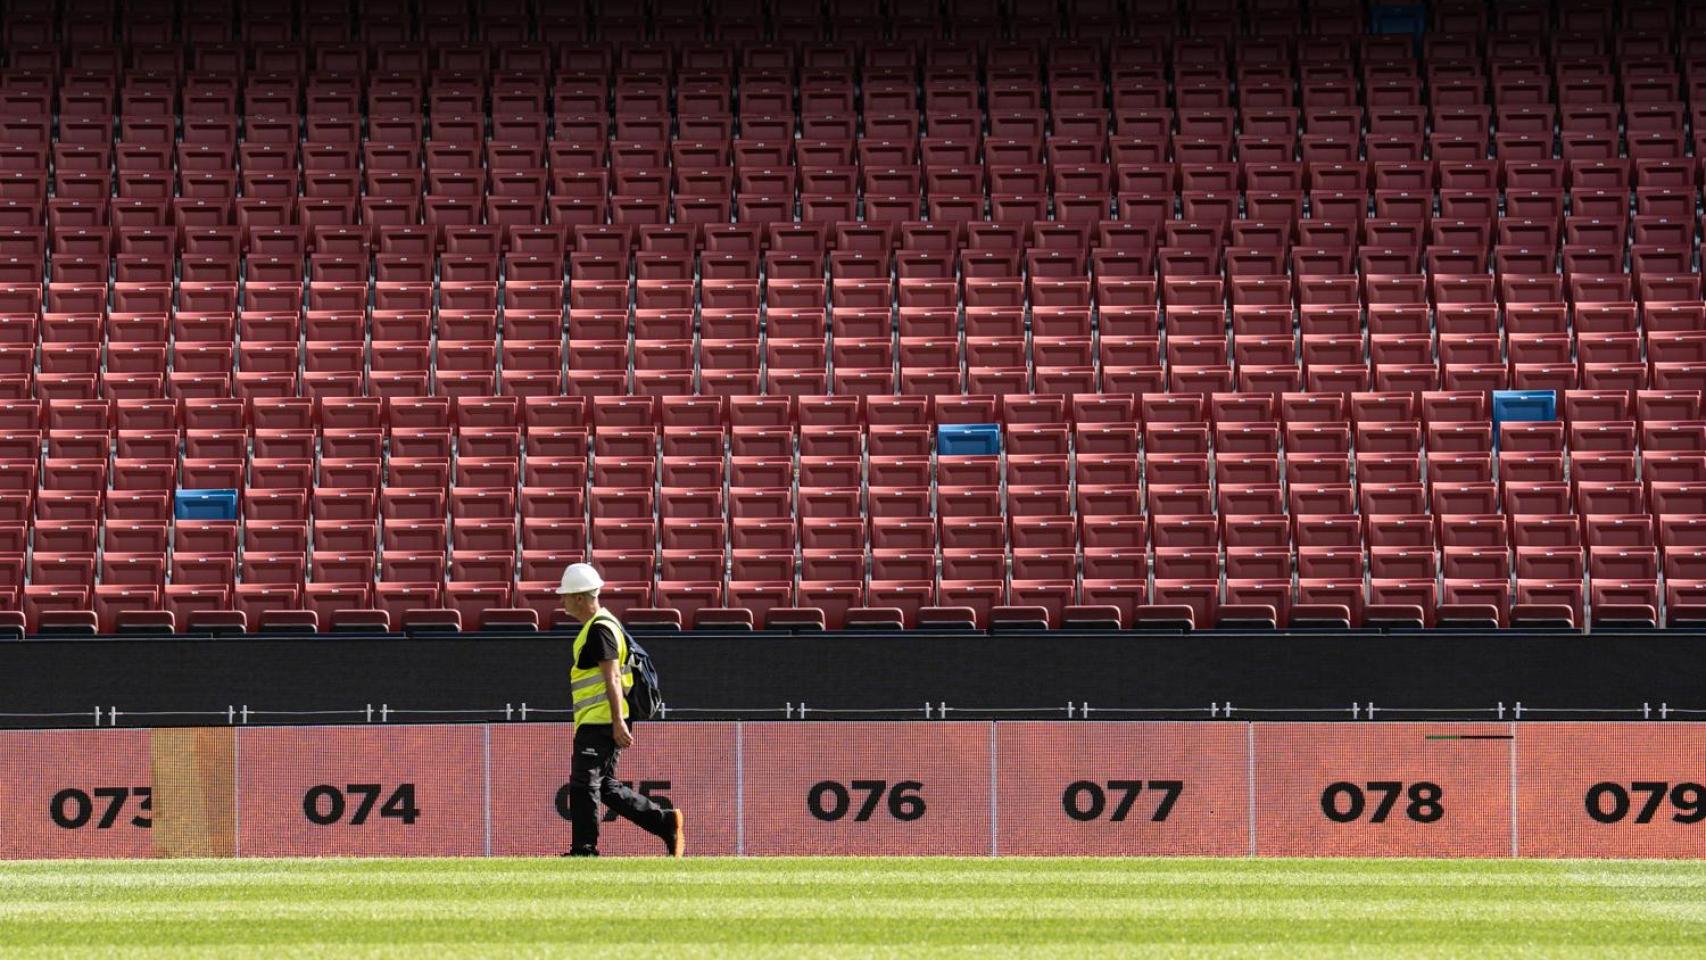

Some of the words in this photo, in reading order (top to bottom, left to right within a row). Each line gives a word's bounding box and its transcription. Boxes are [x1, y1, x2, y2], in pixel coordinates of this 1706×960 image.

[303, 784, 420, 825] 074
[808, 780, 926, 822] 076
[1063, 780, 1183, 822] 077
[1321, 781, 1444, 823] 078
[1585, 782, 1706, 824] 079
